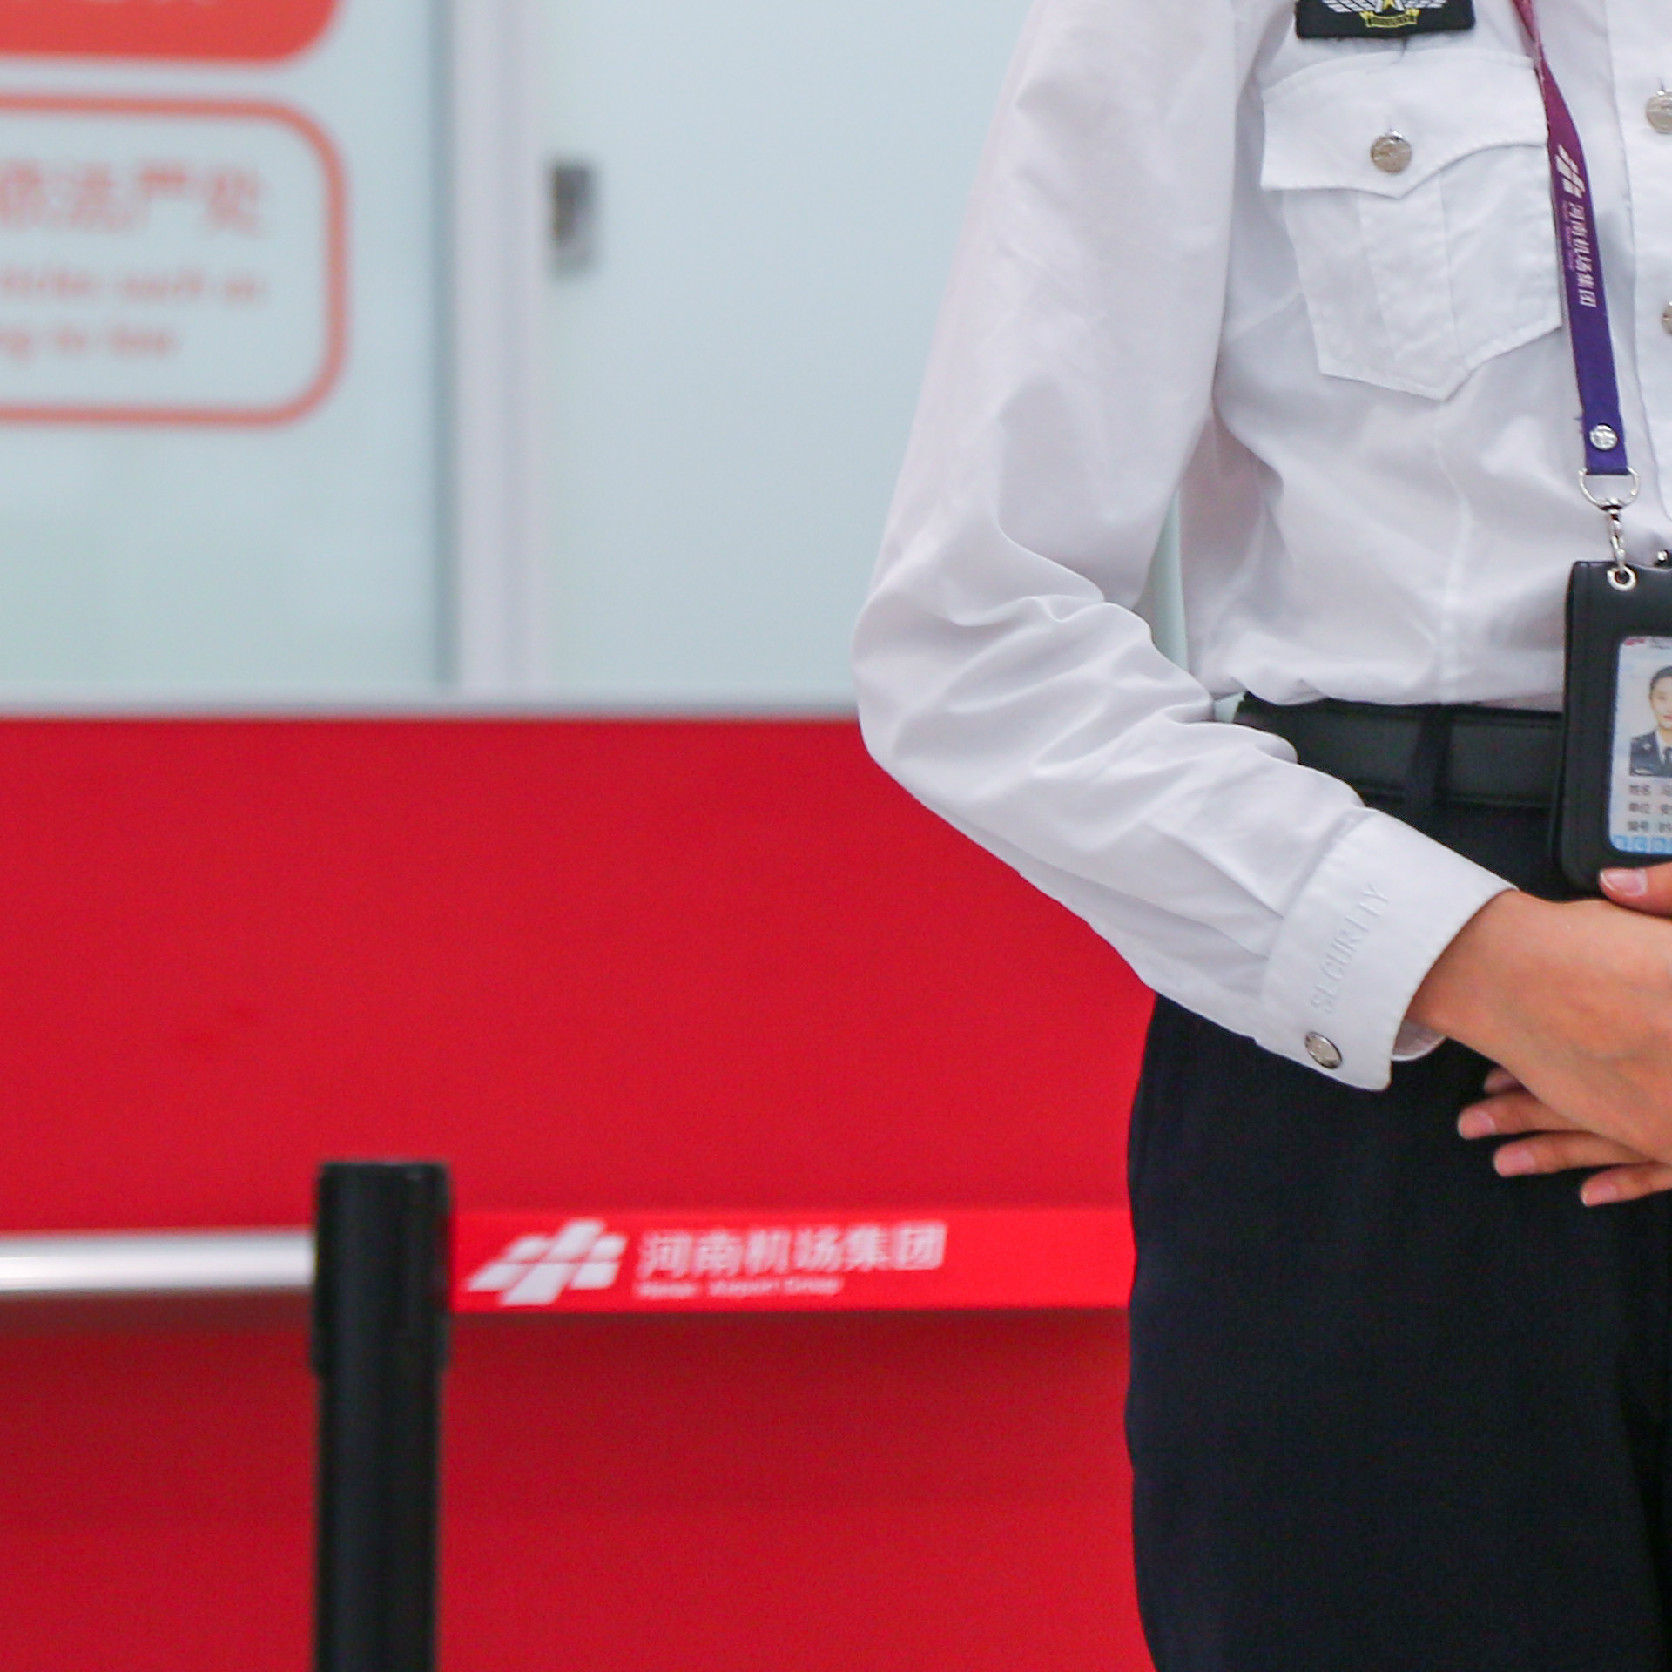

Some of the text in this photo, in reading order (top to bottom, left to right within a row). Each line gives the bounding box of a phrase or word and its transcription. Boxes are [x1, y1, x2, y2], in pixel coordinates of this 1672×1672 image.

[637, 1220, 947, 1278] 河南机场集团
